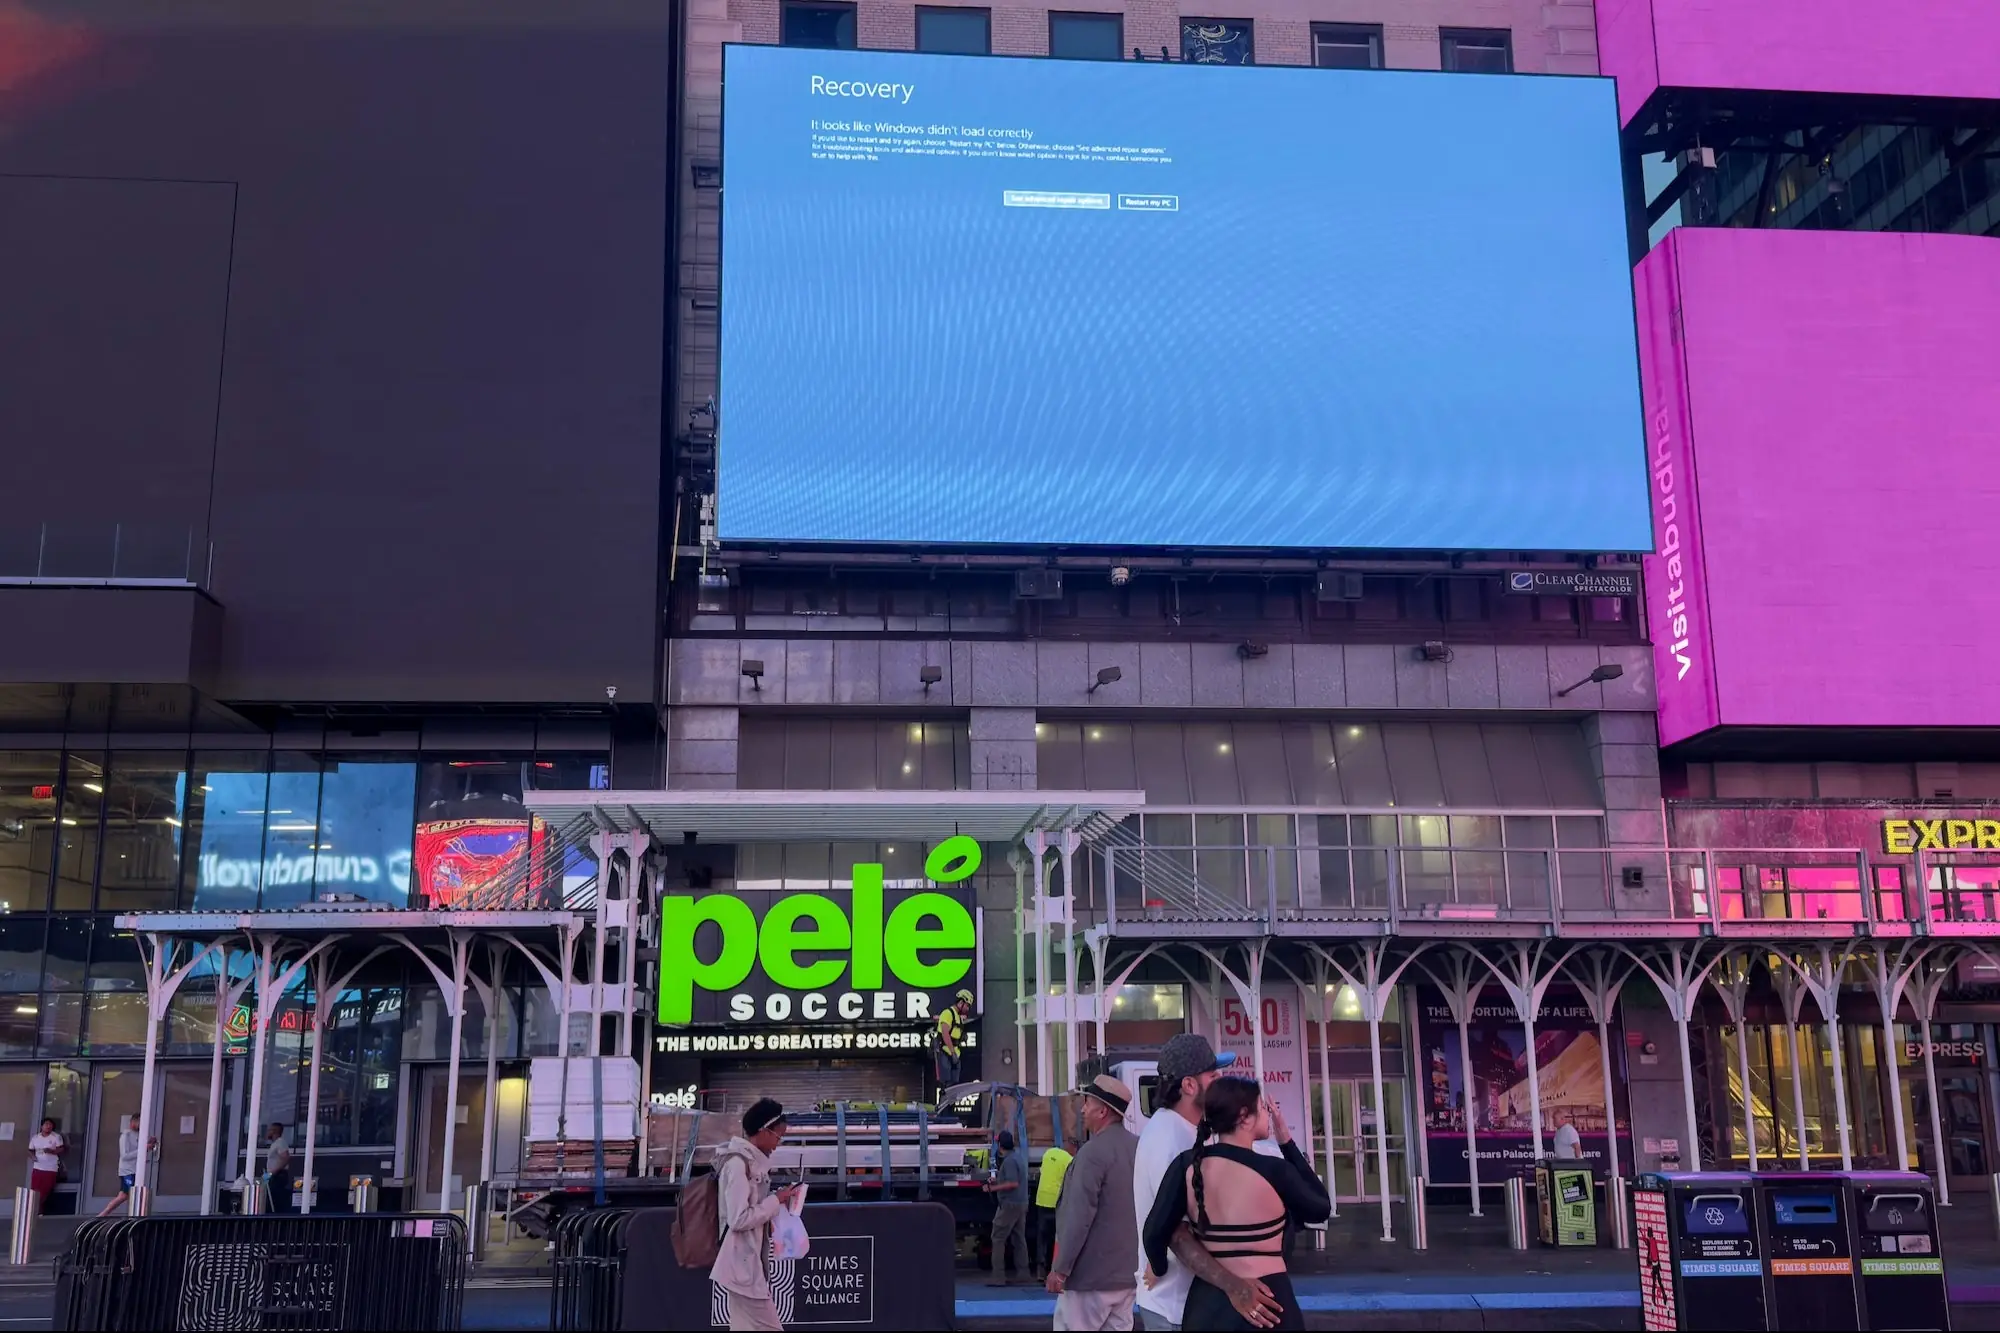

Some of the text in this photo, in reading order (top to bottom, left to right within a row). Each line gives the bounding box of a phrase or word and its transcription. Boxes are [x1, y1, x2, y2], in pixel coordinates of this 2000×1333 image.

[811, 75, 914, 104] Recovery
[811, 120, 1034, 141] It looks like Windows didn't load correctly
[923, 138, 946, 146] choose
[1052, 143, 1075, 151] choose
[1091, 144, 1120, 153] advanced
[1125, 198, 1172, 208] Restart my PC
[1885, 819, 2000, 853] EXPR
[657, 834, 982, 1023] pelé
[729, 991, 931, 1021] SOCCER
[1427, 1007, 1450, 1017] THE
[1553, 1007, 1562, 1017] A
[656, 1035, 690, 1052] THE
[693, 1034, 765, 1051] WORLD'S
[767, 1033, 853, 1051] GREATEST
[855, 1032, 921, 1049] SOCCER
[1263, 1040, 1292, 1049] LAGSHIP
[1503, 1148, 1535, 1159] Palace
[808, 1256, 859, 1270] TIMES
[1683, 1263, 1759, 1273] TIMES SQUARE
[1774, 1262, 1849, 1272] TIMES SQUARE
[1864, 1262, 1940, 1272] TIMES SQUARE
[802, 1274, 864, 1292] SQUARE
[805, 1293, 861, 1305] ALLIANCE
